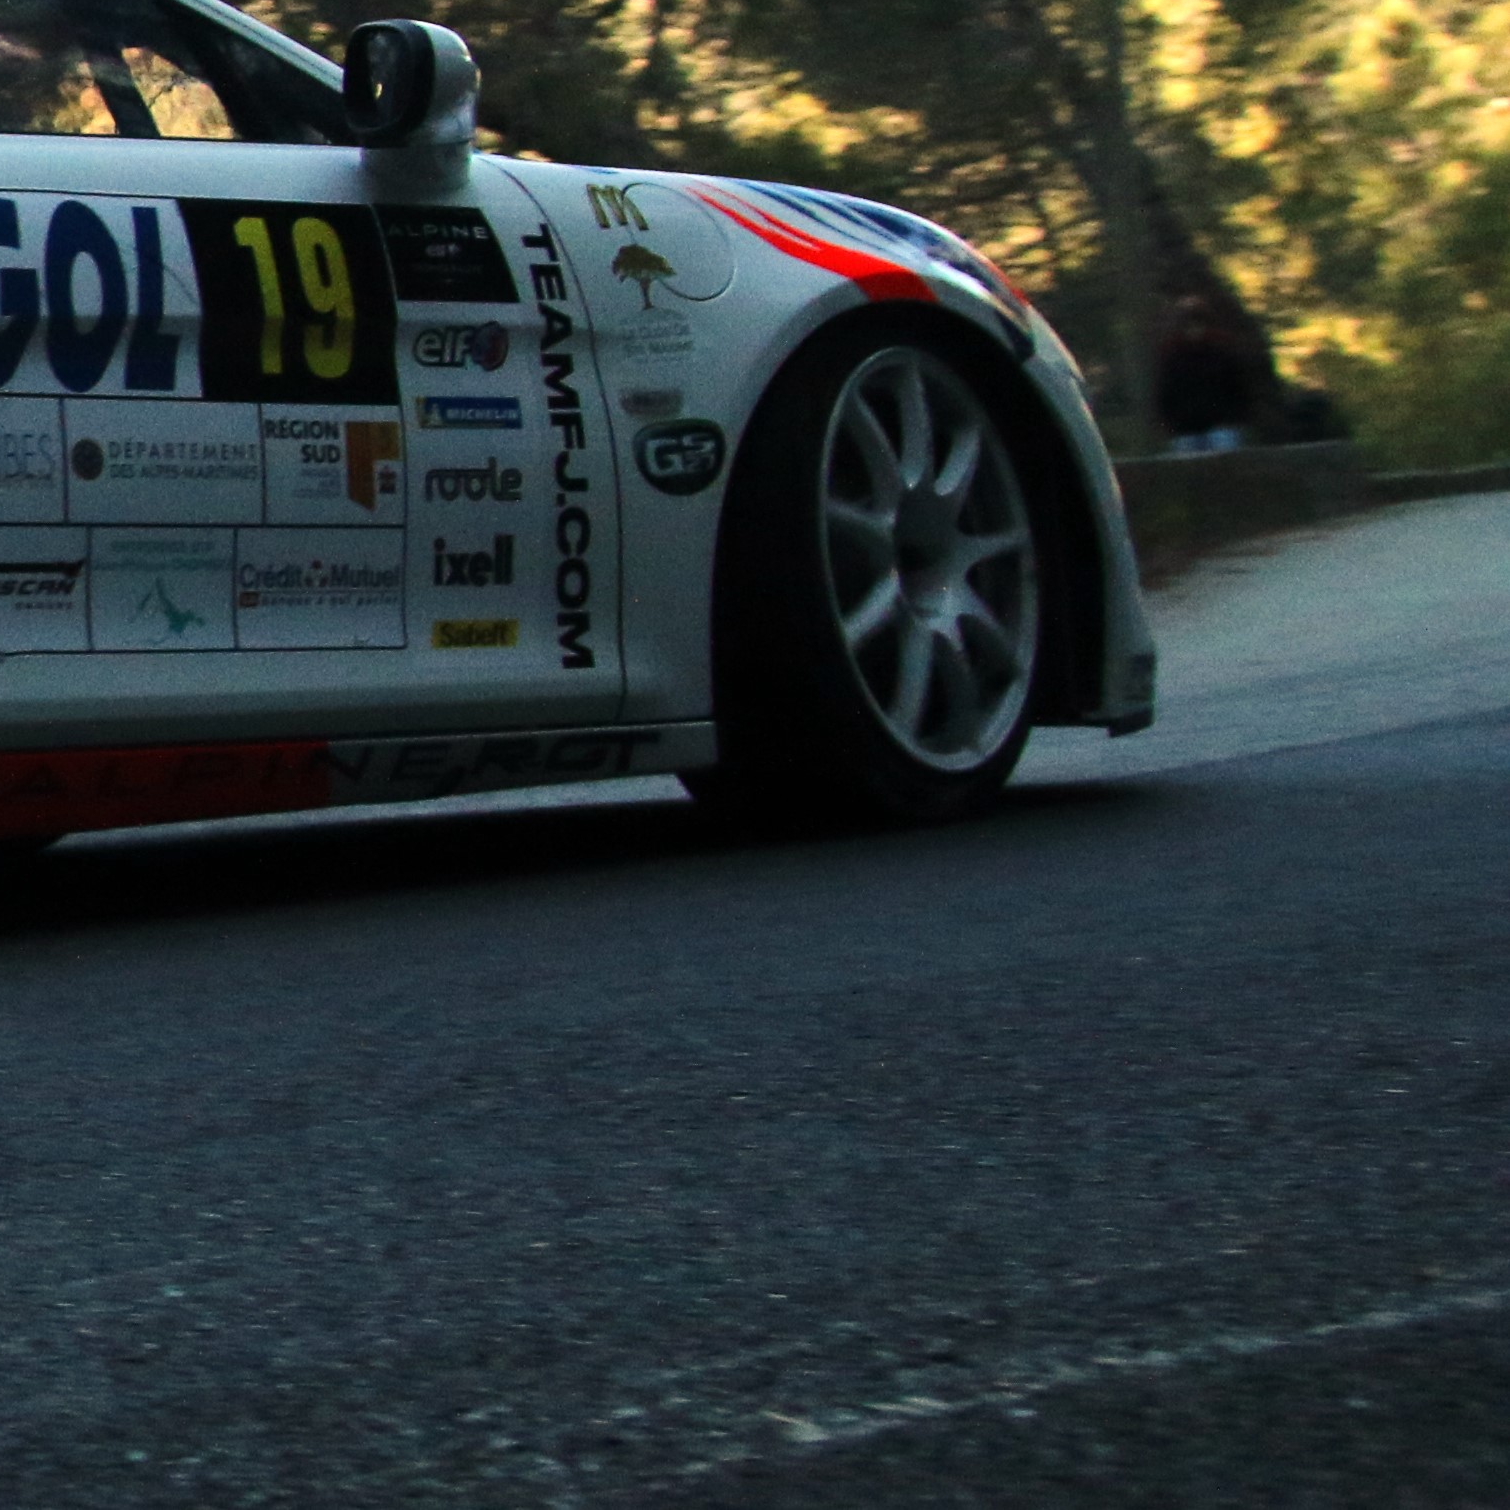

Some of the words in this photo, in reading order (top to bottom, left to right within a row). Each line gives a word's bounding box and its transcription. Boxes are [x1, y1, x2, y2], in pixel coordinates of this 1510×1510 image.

[387, 222, 490, 241] ALPINE
[233, 216, 357, 380] 19
[413, 326, 476, 367] elf
[301, 443, 342, 464] SUD
[521, 223, 595, 669] TEAMFJ.COM
[433, 533, 515, 587] ixell
